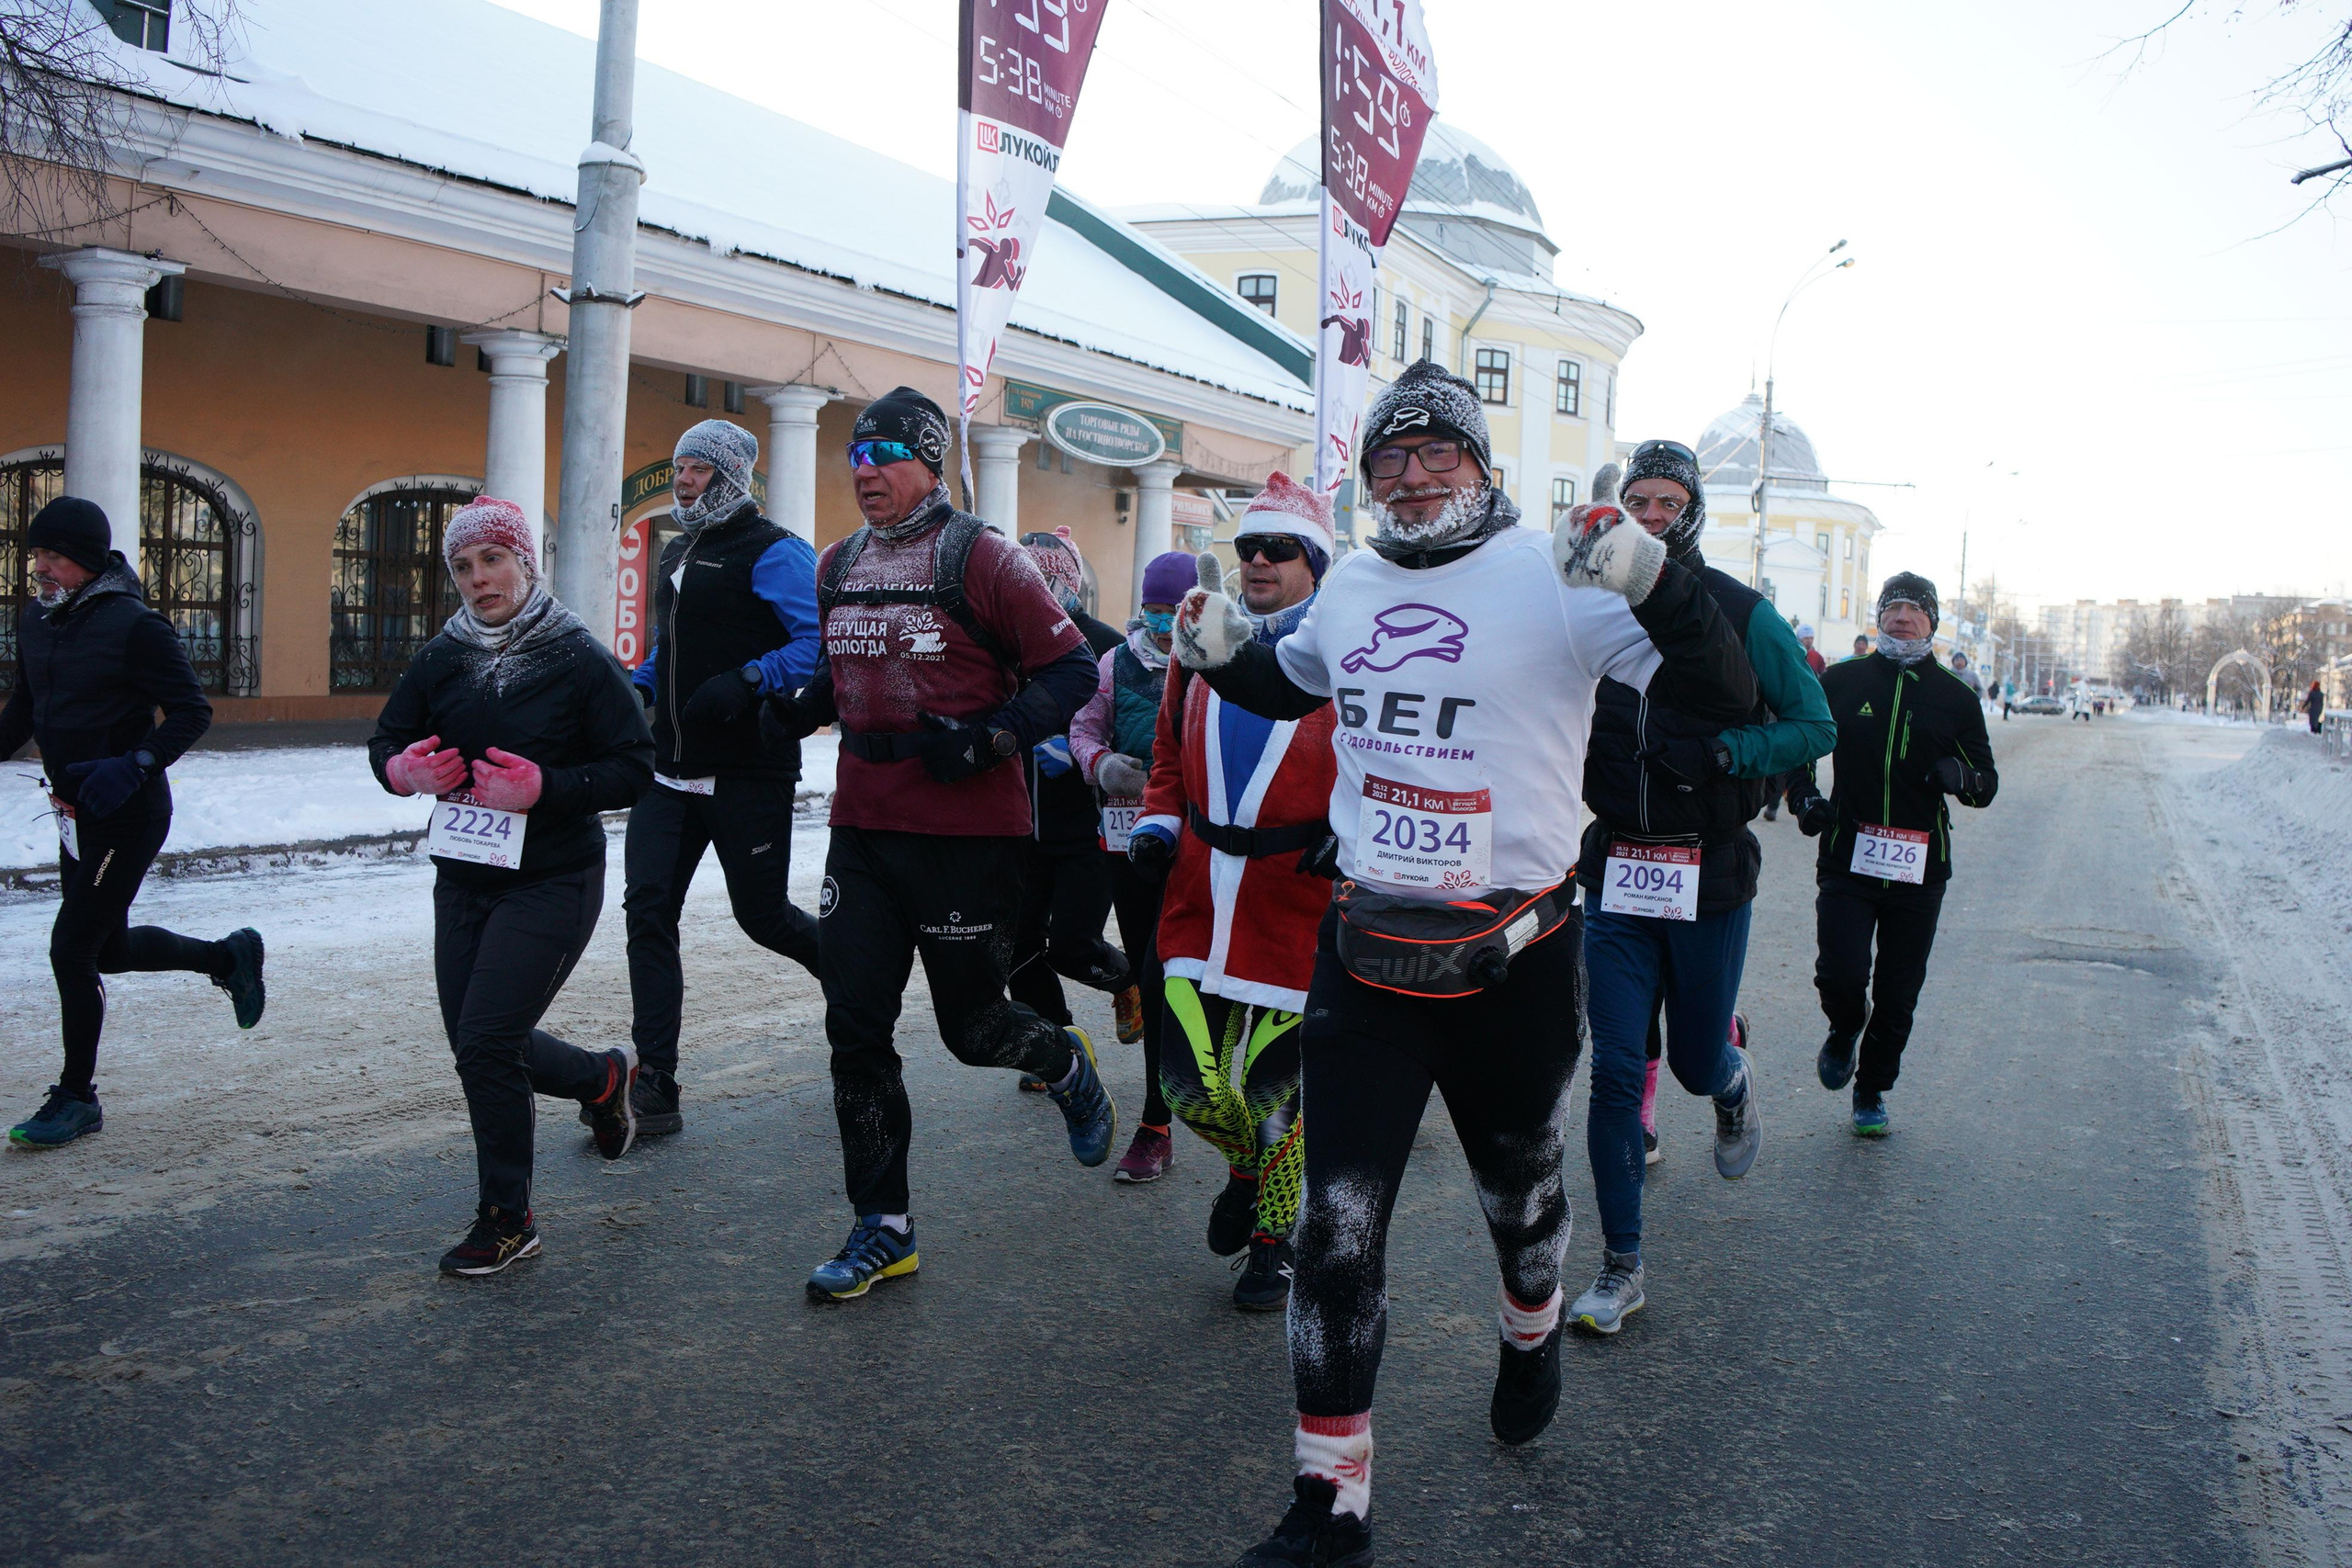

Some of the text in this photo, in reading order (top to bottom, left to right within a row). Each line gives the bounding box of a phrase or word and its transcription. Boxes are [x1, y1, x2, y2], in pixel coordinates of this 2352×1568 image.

[978, 35, 1043, 105] 5:38
[1044, 82, 1072, 108] MINUTE
[1335, 22, 1400, 160] 1:59
[999, 131, 1060, 174] ЛУКОЙЛ
[1331, 124, 1369, 201] 5:38
[1368, 180, 1394, 211] MINUTE
[1066, 427, 1077, 439] НА
[1080, 413, 1119, 434] ТОРГОВЫЕ
[1120, 423, 1140, 437] РЯДЫ
[633, 467, 674, 502] ДОБР
[751, 482, 767, 502] ВА
[695, 559, 723, 569] noname
[616, 568, 639, 670] ОБО
[828, 620, 888, 638] БЕГУЩАЯ
[828, 639, 888, 658] ВОЛОГДА
[899, 652, 945, 661] 05.12.2021
[1337, 687, 1476, 739] БЕГ
[1340, 732, 1347, 742] С
[462, 793, 483, 807] 21,
[1114, 797, 1125, 807] 21,1
[1372, 790, 1387, 800] 2021
[1373, 783, 1444, 810] 05.12 21,1 КМ
[443, 807, 512, 840] 2224
[1109, 809, 1145, 830] 213
[1372, 809, 1472, 854] 2034
[1876, 828, 1894, 838] 21,1
[1896, 832, 1907, 840] КМ
[449, 835, 501, 849] ЛЮБОВЬ ТОКАРЕВА
[1863, 839, 1917, 863] 2126
[1376, 850, 1462, 867] ДМИТРИЙ ВИКТОРОВ
[1631, 848, 1651, 860] 21,1
[1653, 852, 1668, 861] КМ
[94, 848, 116, 886] NORDSKI
[1401, 873, 1430, 883] ЛУКОЙЛ
[1616, 863, 1684, 894] 2094
[1623, 892, 1673, 903] РОМАН КИРСАНОВ
[920, 924, 943, 934] CARL
[950, 922, 993, 934] BUCHERER
